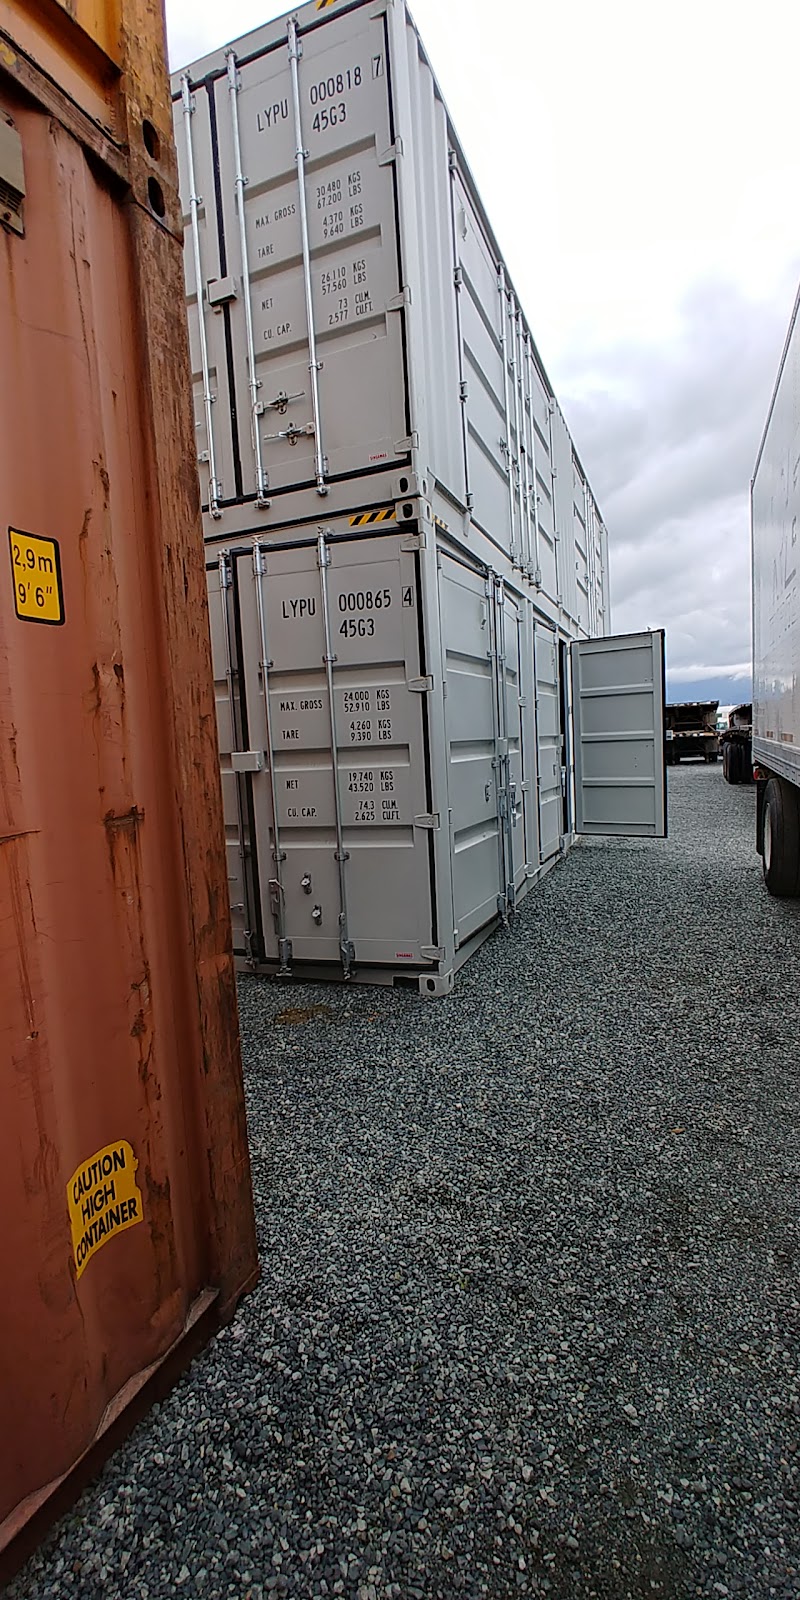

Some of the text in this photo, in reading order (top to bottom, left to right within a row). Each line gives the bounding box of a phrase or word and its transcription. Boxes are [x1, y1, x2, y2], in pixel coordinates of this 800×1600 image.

[257, 55, 381, 132] LYPU 000818 7
[312, 103, 346, 132] 45G3
[348, 171, 361, 186] KGS
[317, 184, 362, 209] 67.200 LBS
[255, 204, 296, 229] MAX. GROSS
[322, 203, 363, 228] 4.370 KGS
[324, 215, 364, 239] 9.640 LBS
[257, 244, 274, 259] TARE
[322, 260, 366, 284] 26.110 KGS
[322, 272, 367, 296] 57.560 LBS
[262, 298, 273, 311] NET
[338, 298, 348, 310] 73
[328, 310, 348, 325] 2.577
[263, 323, 292, 340] CU. CAP.
[282, 588, 412, 619] LYPU 000865 4
[340, 618, 375, 638] 45G3
[344, 690, 390, 701] 24.000 KGS
[280, 700, 322, 711] MAX. GROSS
[344, 701, 390, 712] 52.910 LBS
[350, 719, 391, 730] 4.260 KGS
[282, 730, 299, 740] TARE
[351, 730, 391, 741] 9.390 LBS
[348, 771, 393, 782] 19.740 KGS
[286, 780, 298, 790] NET
[348, 782, 394, 792] 43.520 LBS
[288, 808, 317, 818] CU. CAP.
[359, 801, 375, 810] 74.3
[355, 811, 375, 821] 2.625
[73, 1147, 126, 1205] CAUTION
[81, 1180, 116, 1226] HIGH
[76, 1197, 138, 1267] CONTAINER
